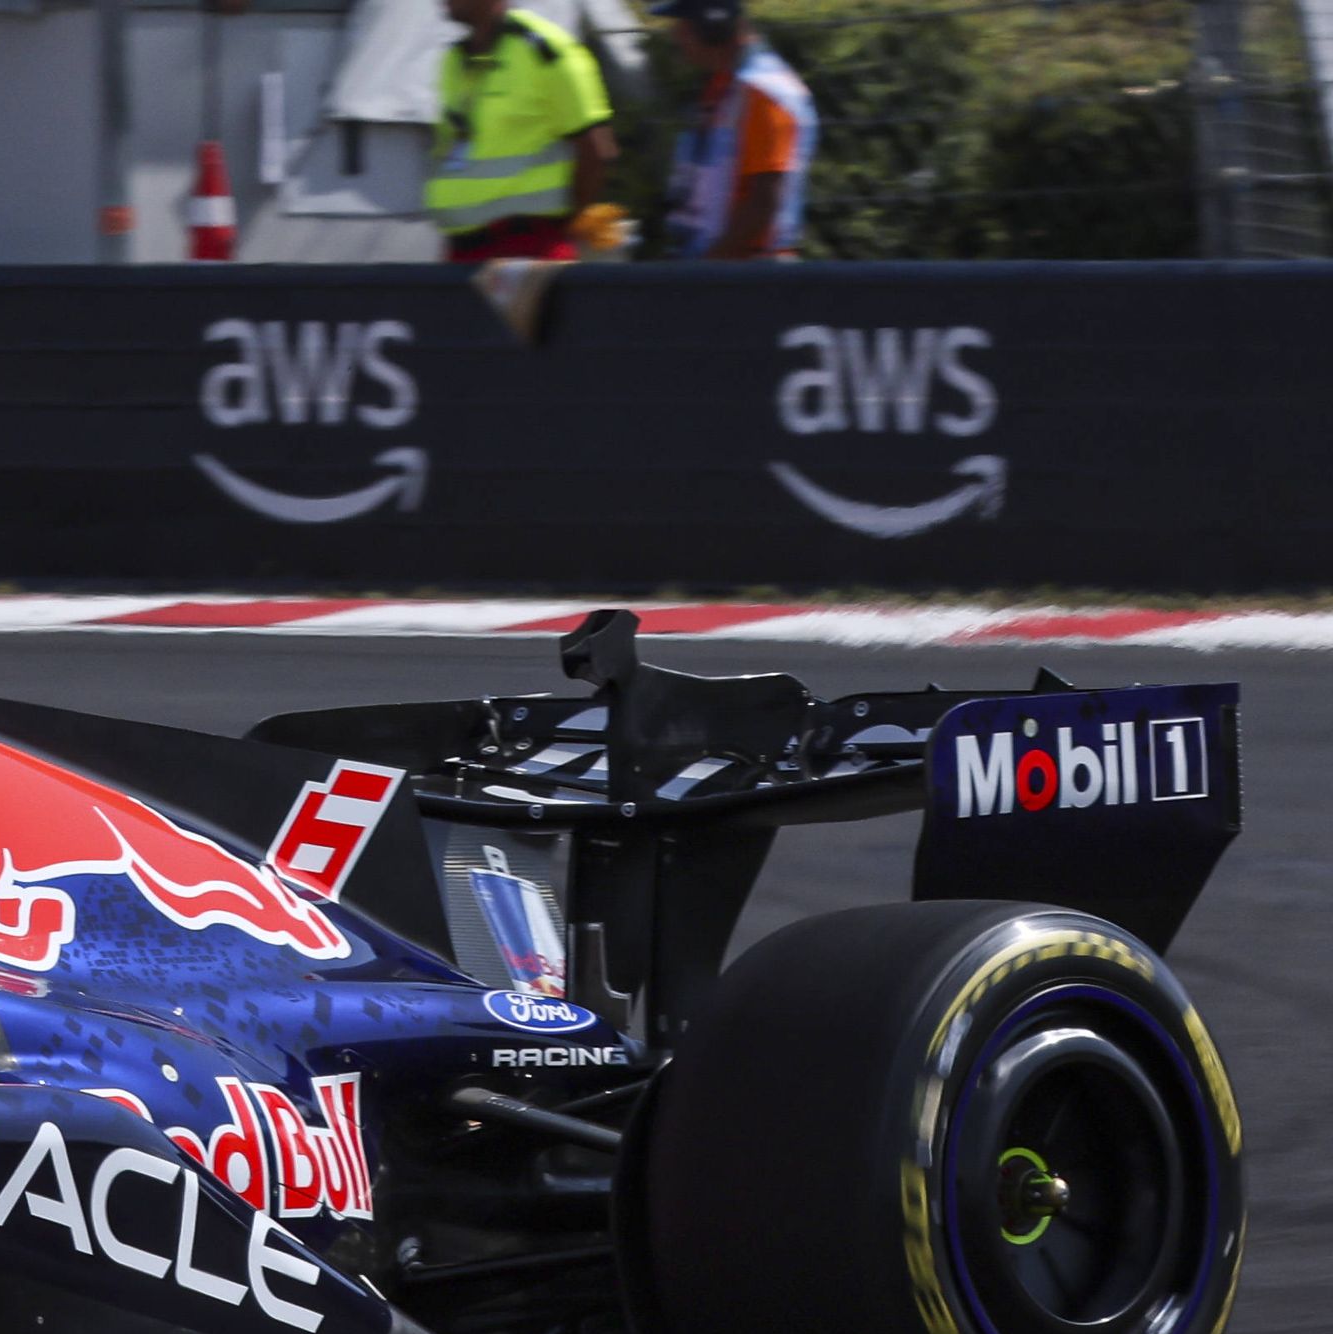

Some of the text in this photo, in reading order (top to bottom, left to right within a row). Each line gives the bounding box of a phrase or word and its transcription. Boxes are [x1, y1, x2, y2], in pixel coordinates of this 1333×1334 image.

[200, 318, 418, 428] aws
[778, 325, 998, 437] aws
[955, 721, 1139, 819] Mobil
[1164, 725, 1189, 795] 1
[492, 1047, 629, 1068] RACING
[245, 1072, 373, 1221] Bull
